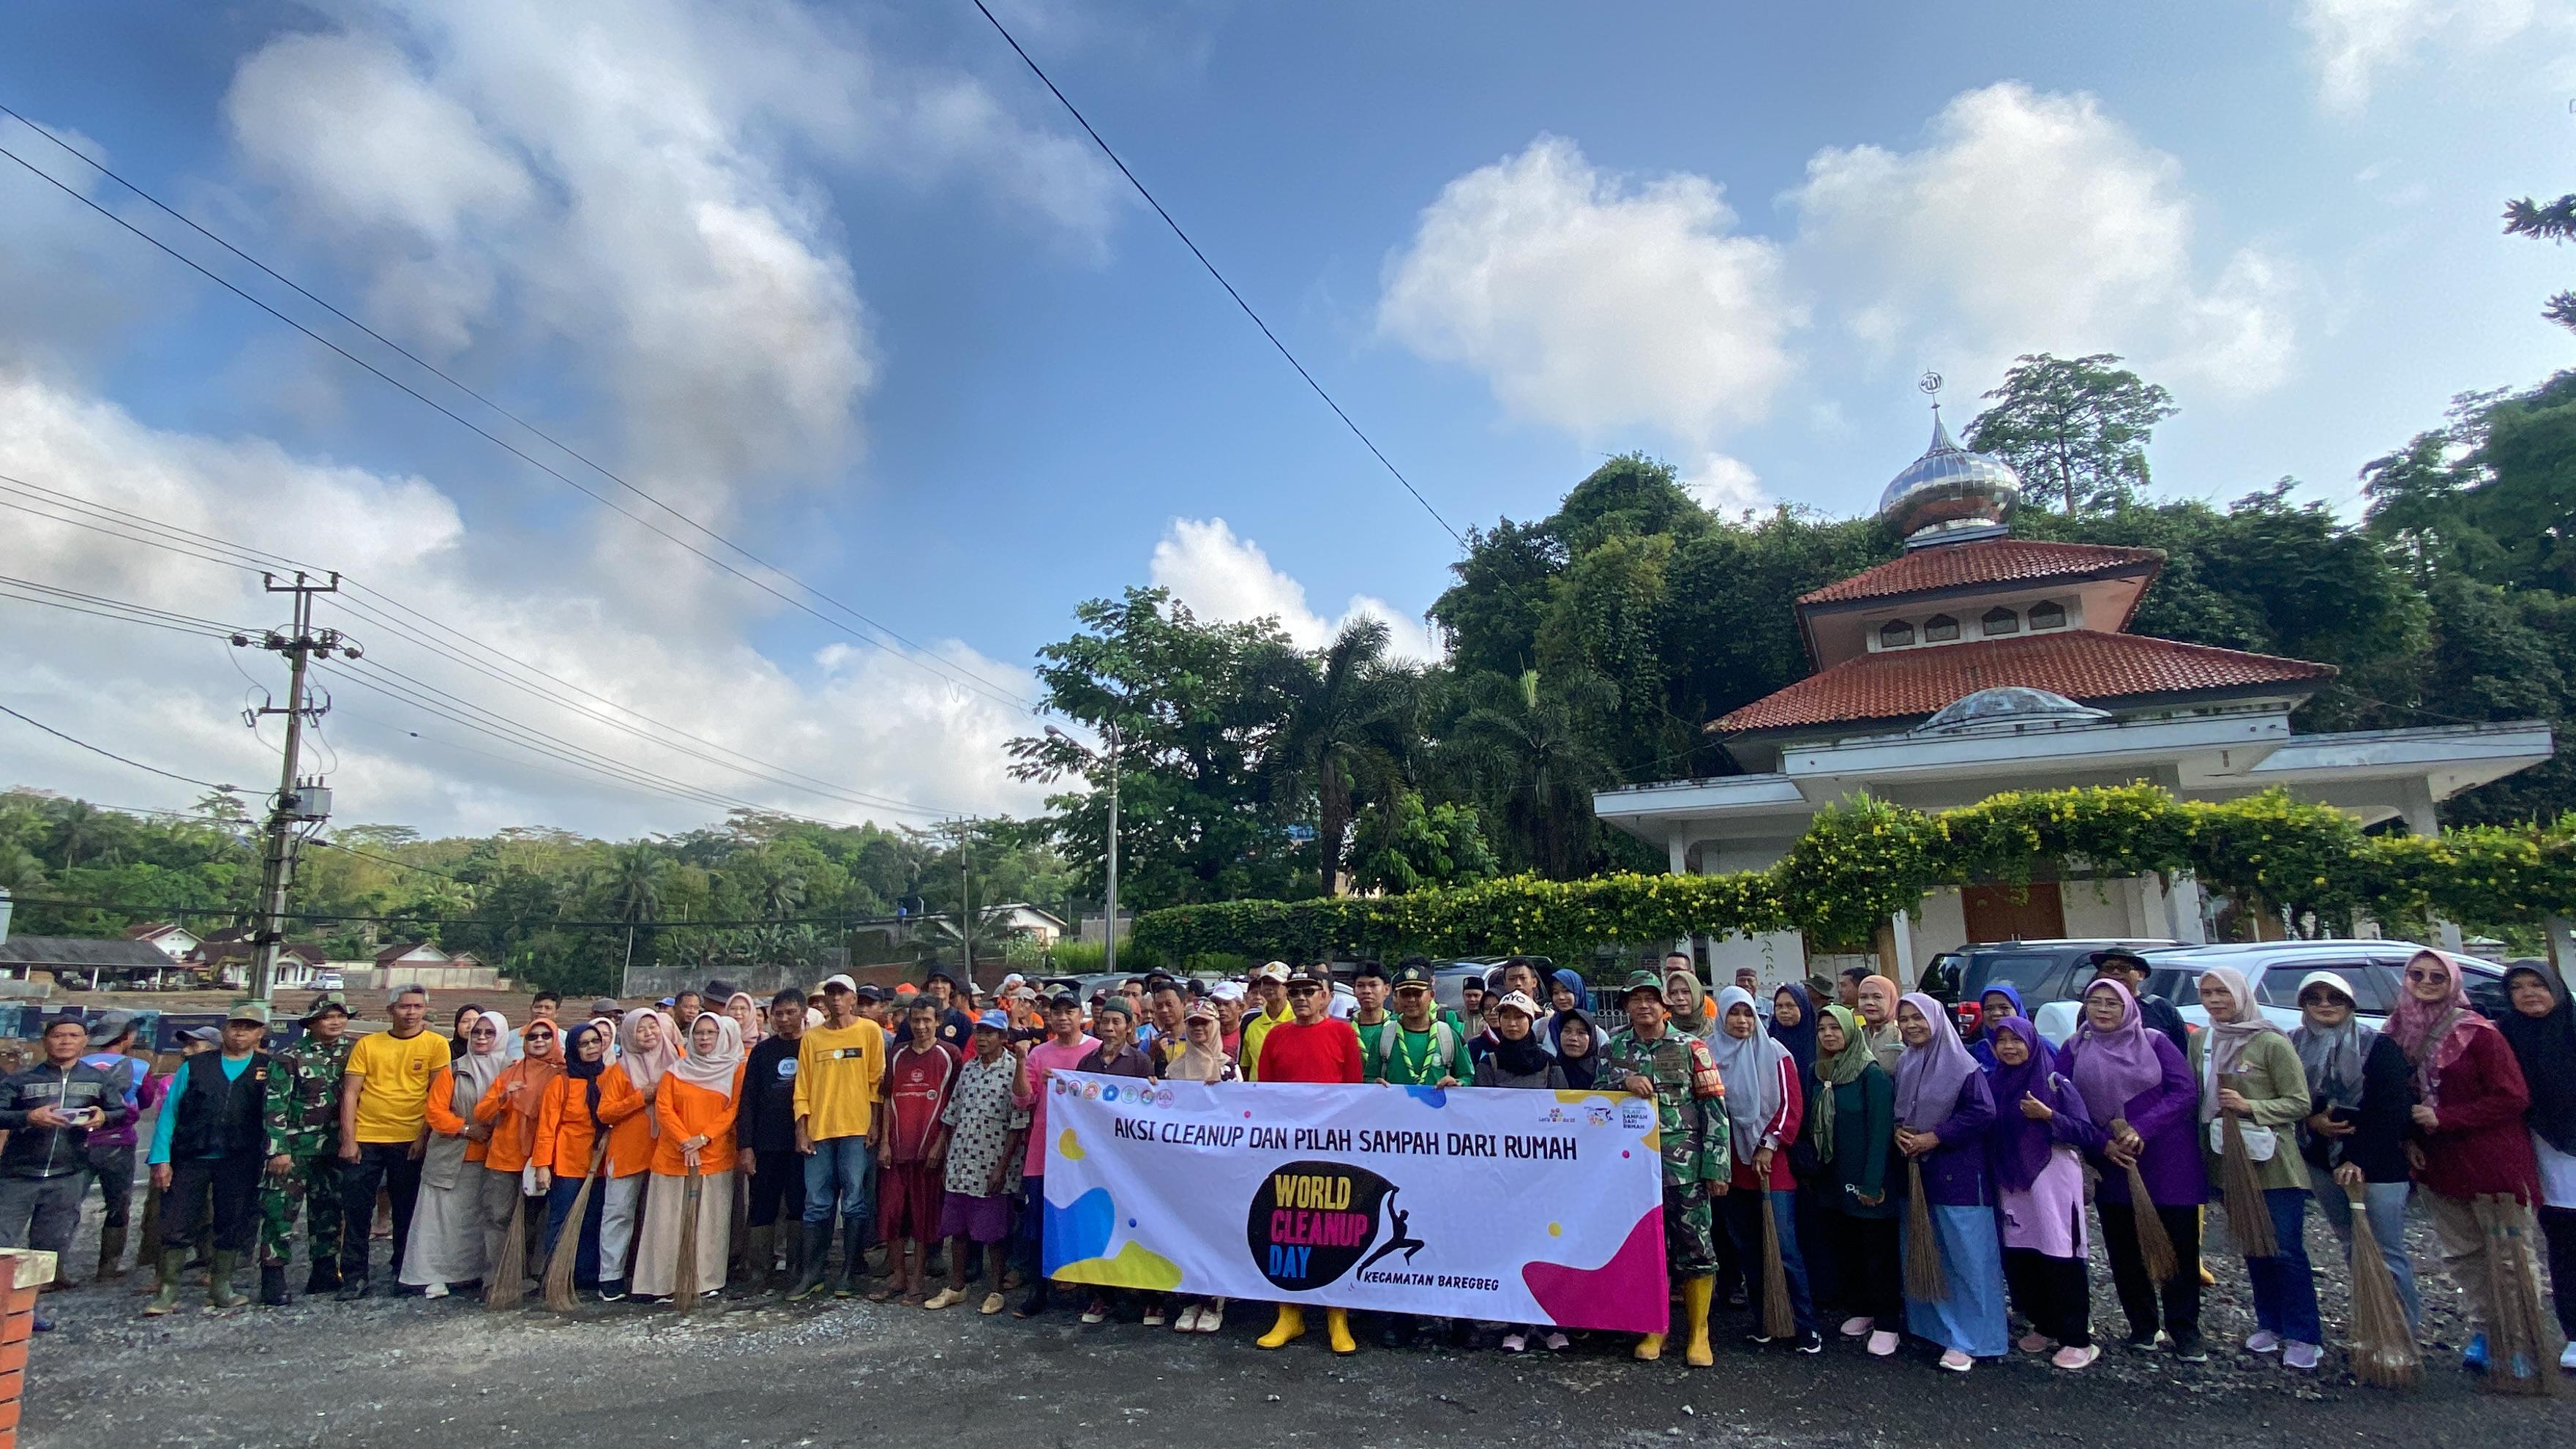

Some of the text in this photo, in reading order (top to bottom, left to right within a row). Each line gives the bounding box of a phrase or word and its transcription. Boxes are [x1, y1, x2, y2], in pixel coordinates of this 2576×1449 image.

[1502, 994, 1526, 1003] NYC
[1114, 1117, 1577, 1160] AKSI CLEANUP DAN PILAH SAMPAH DARI RUMAH
[1275, 1175, 1351, 1210] WORLD
[1271, 1210, 1368, 1247] CLEANUP
[1269, 1245, 1311, 1278] DAY
[1363, 1271, 1499, 1291] KECAMATAN BAREGBEG
